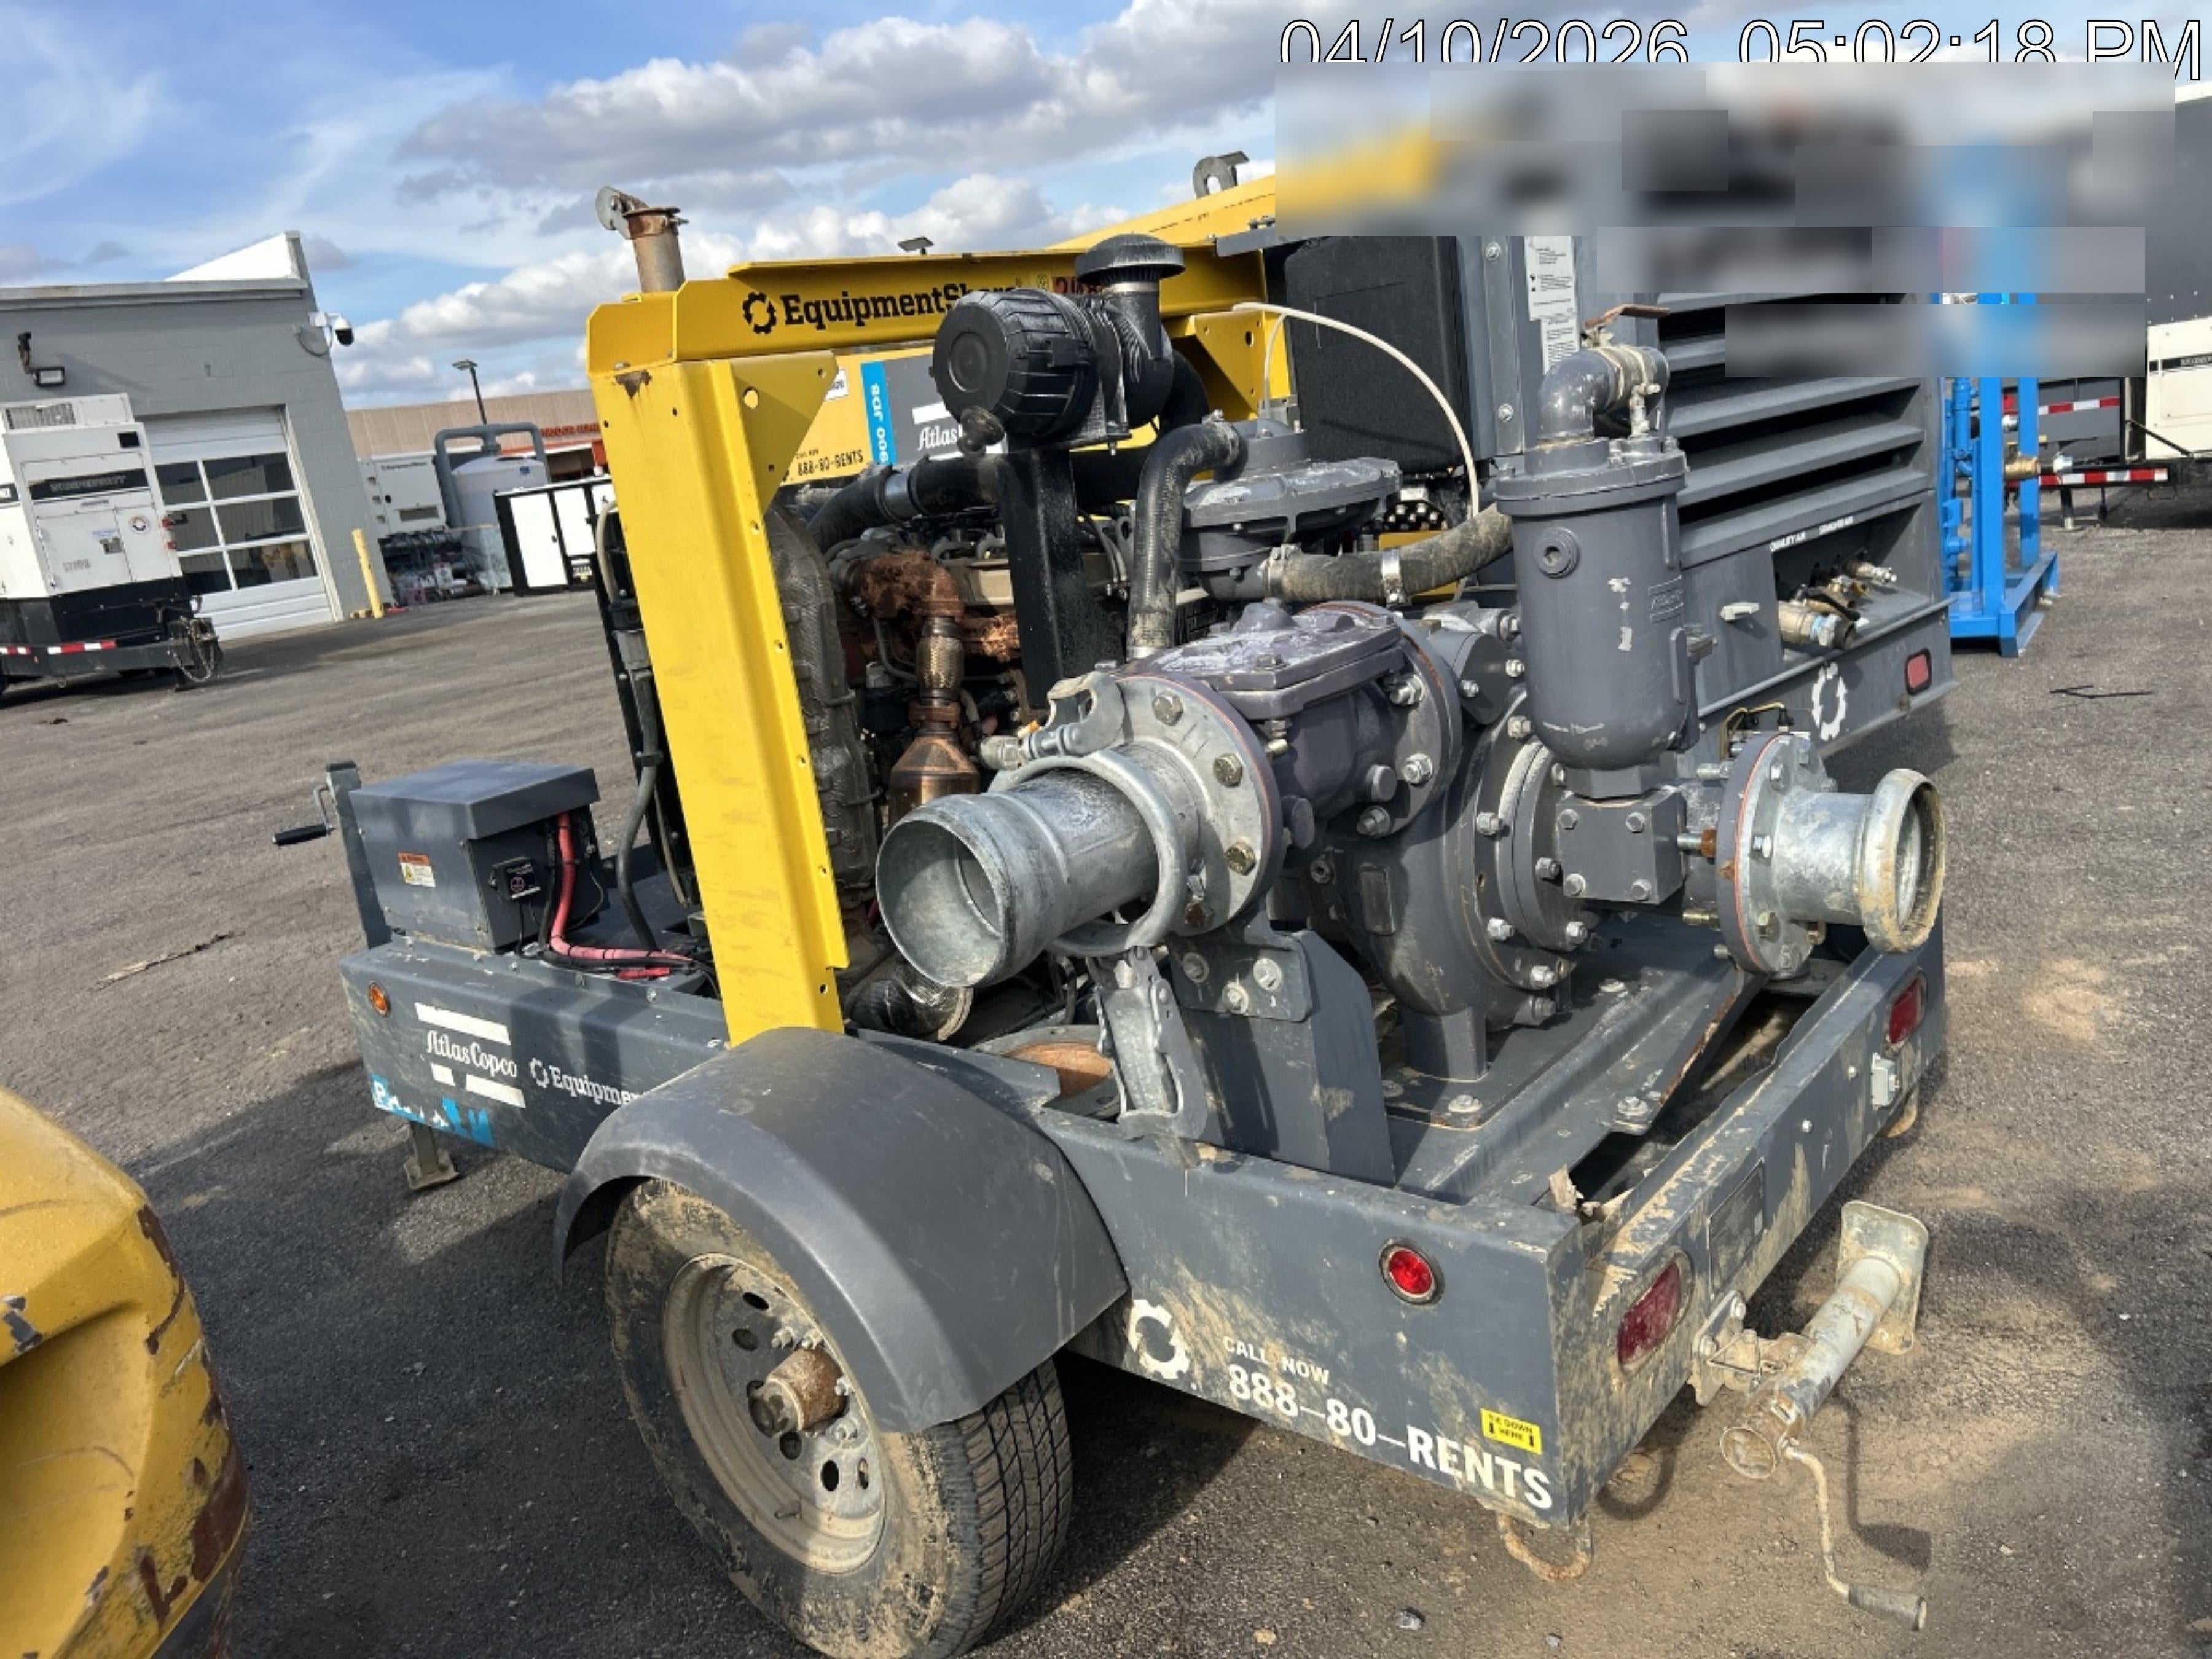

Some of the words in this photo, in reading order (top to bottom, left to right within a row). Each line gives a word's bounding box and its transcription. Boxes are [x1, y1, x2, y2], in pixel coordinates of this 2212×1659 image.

[917, 425, 958, 452] Atlas
[427, 1030, 470, 1064] Atlas
[469, 1041, 517, 1078] Copco
[1223, 1335, 1269, 1365] CALL
[1282, 1355, 1330, 1385] NOW
[1229, 1363, 1553, 1510] 888-80-RENTS
